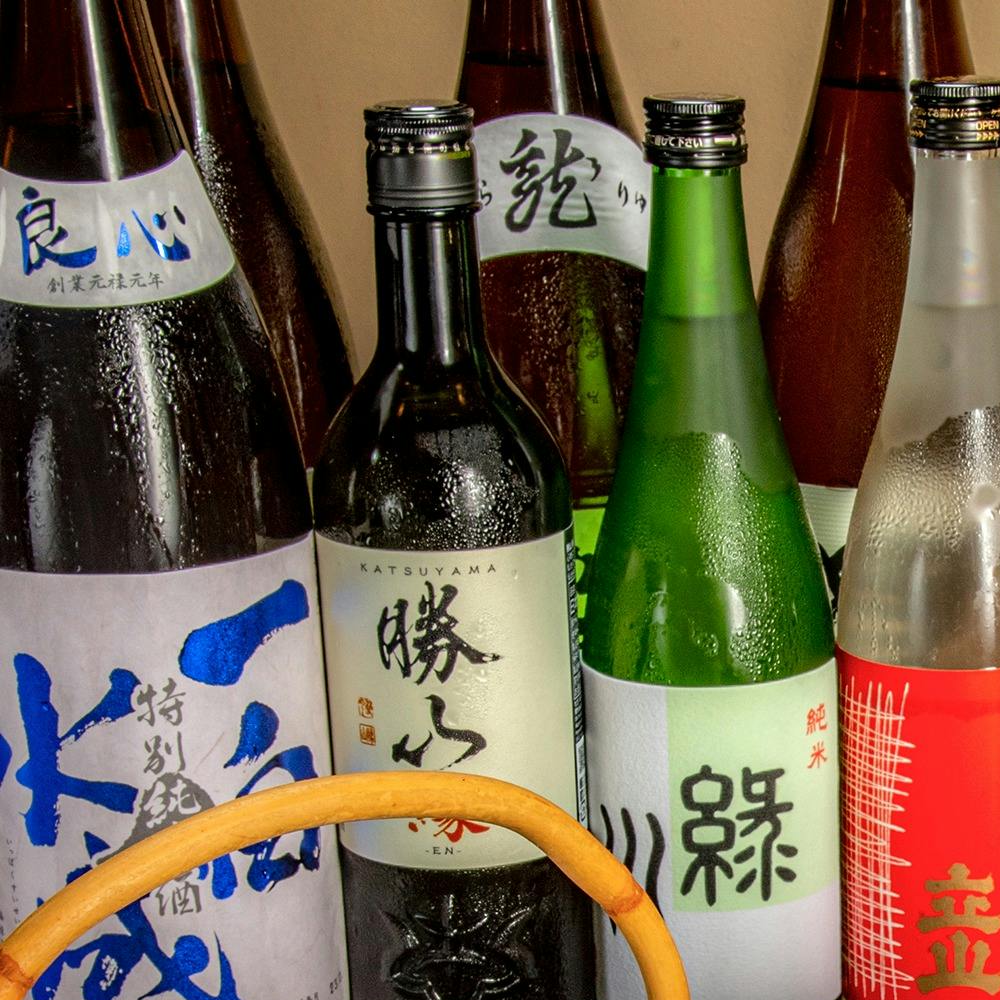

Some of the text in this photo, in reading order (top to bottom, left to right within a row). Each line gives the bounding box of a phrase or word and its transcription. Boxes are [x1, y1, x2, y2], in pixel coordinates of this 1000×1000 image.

[975, 120, 1000, 131] OPEN
[16, 186, 192, 276] 良心
[47, 272, 164, 294] 創業元禄元年
[359, 562, 498, 578] KATSUYAMA
[805, 702, 829, 770] 純米
[135, 676, 203, 918] 特別純酒
